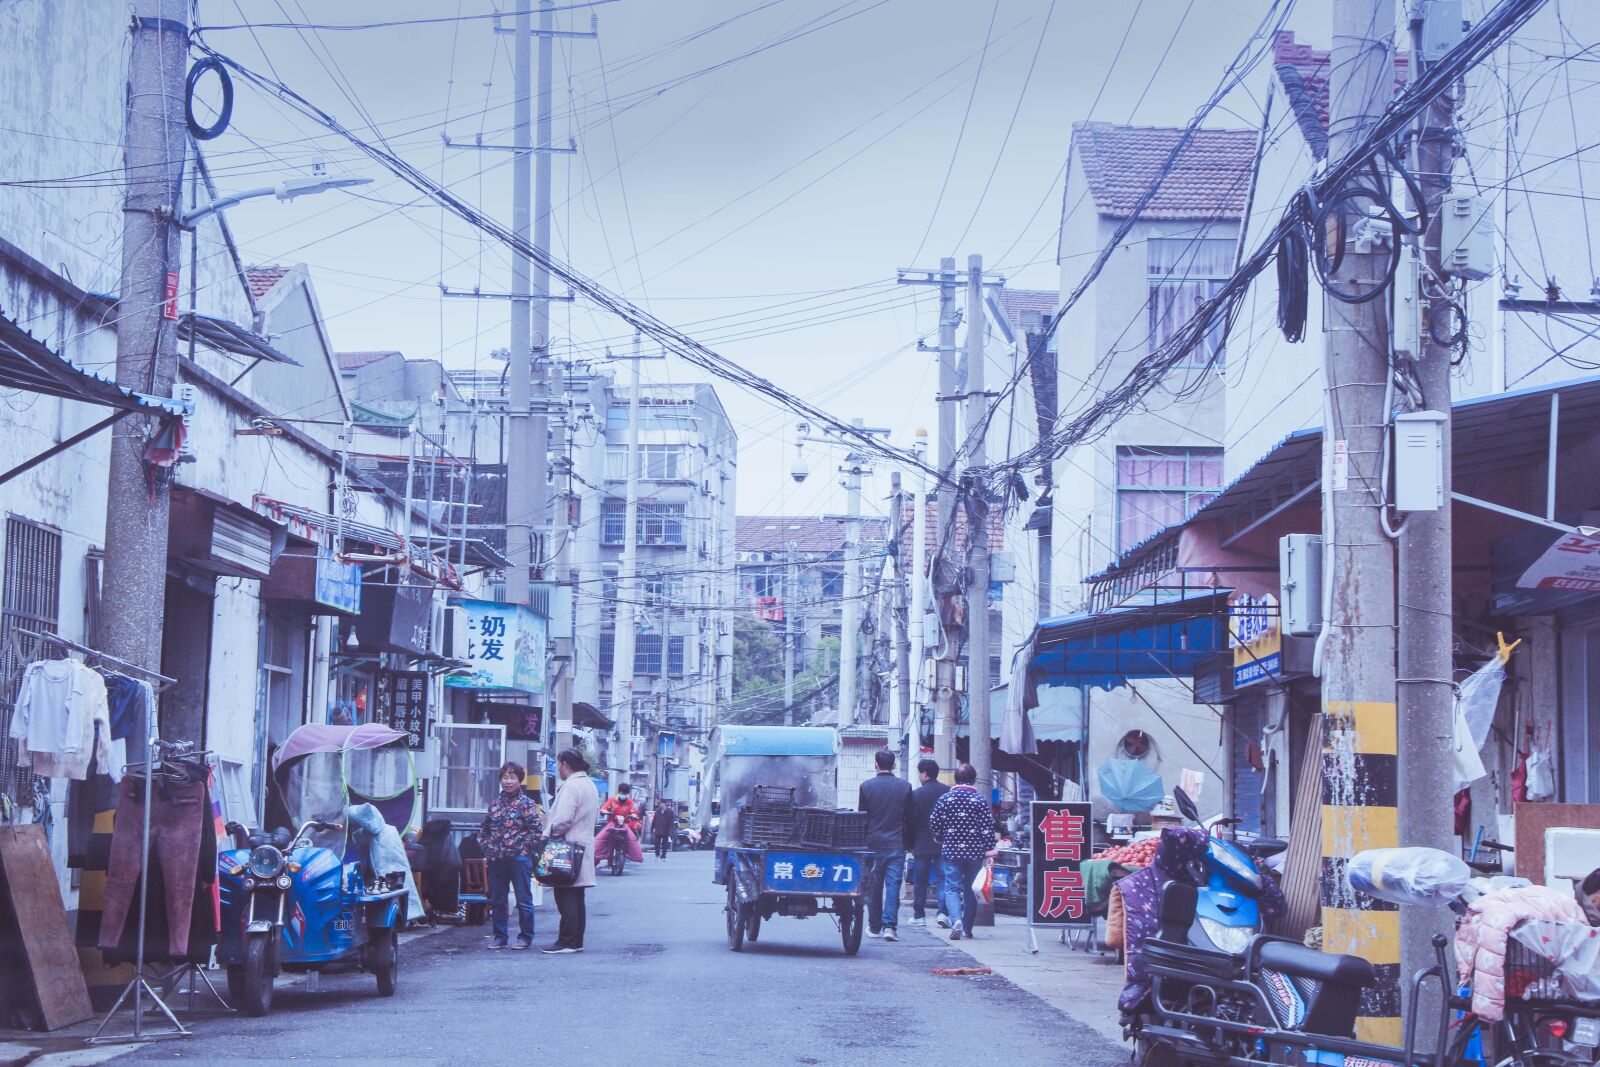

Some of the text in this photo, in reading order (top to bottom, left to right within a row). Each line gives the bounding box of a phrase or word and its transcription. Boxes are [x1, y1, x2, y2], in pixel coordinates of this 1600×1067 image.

[773, 861, 853, 882] 常 力
[1038, 808, 1086, 919] 售房
